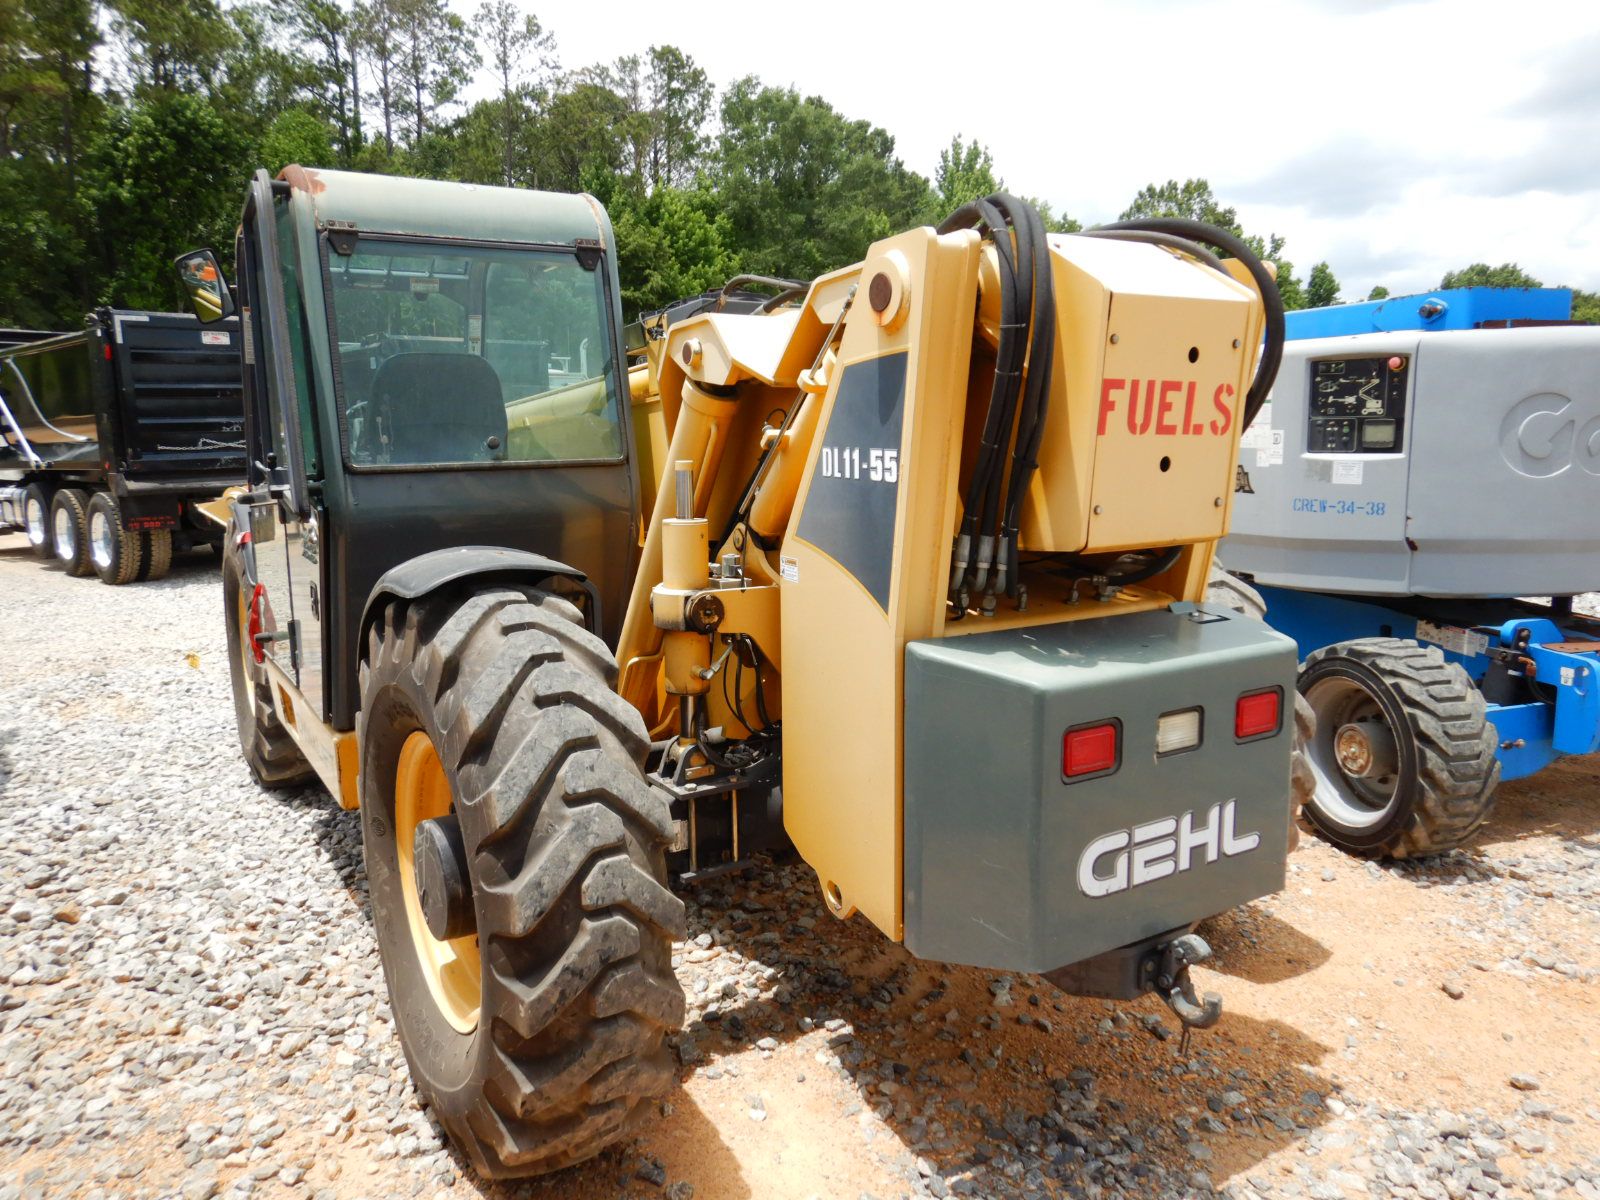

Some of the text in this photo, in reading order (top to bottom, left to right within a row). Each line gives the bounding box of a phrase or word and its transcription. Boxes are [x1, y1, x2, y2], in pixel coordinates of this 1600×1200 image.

[1097, 378, 1234, 436] FUELS
[822, 446, 898, 483] DL11-55
[1292, 498, 1385, 516] CREW-34-38
[1076, 798, 1261, 899] GEHL
